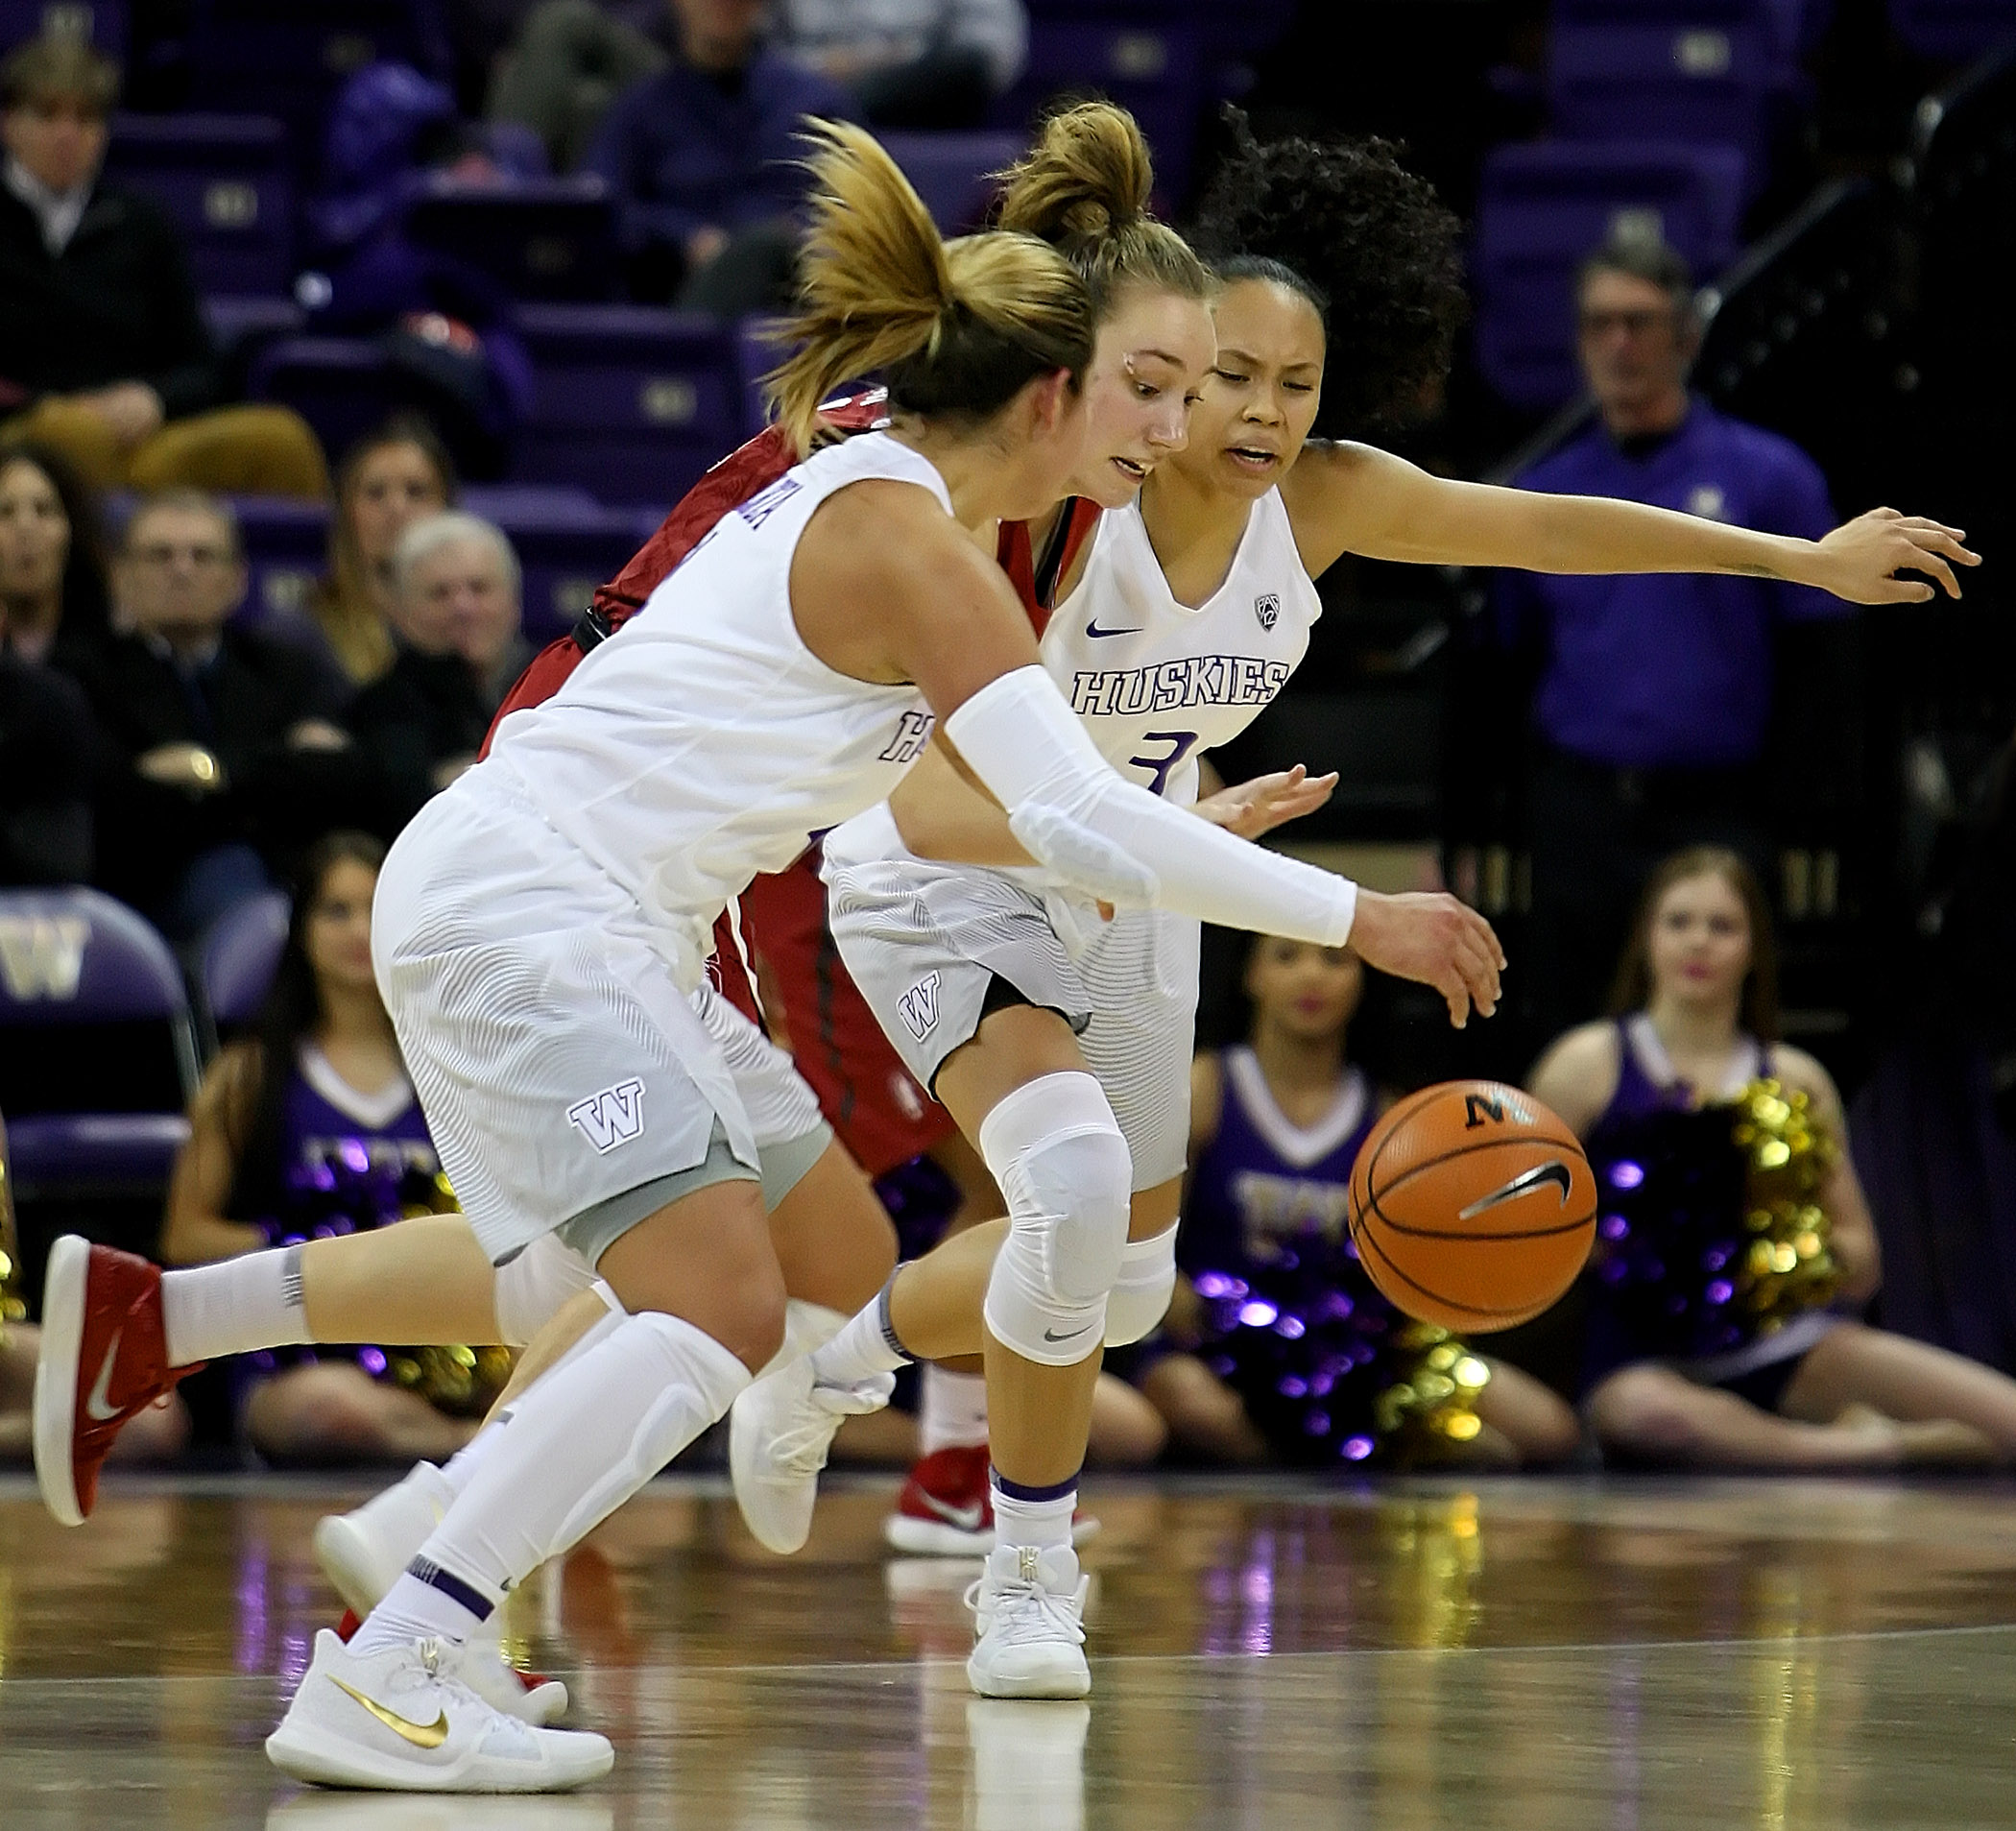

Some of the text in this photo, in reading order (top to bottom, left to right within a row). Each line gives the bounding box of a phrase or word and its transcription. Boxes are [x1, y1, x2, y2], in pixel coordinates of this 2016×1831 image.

[1262, 610, 1277, 626] 12
[1070, 655, 1289, 715] HUSKIES
[0, 917, 93, 1000] W
[897, 971, 940, 1042] W
[567, 1079, 642, 1151] W
